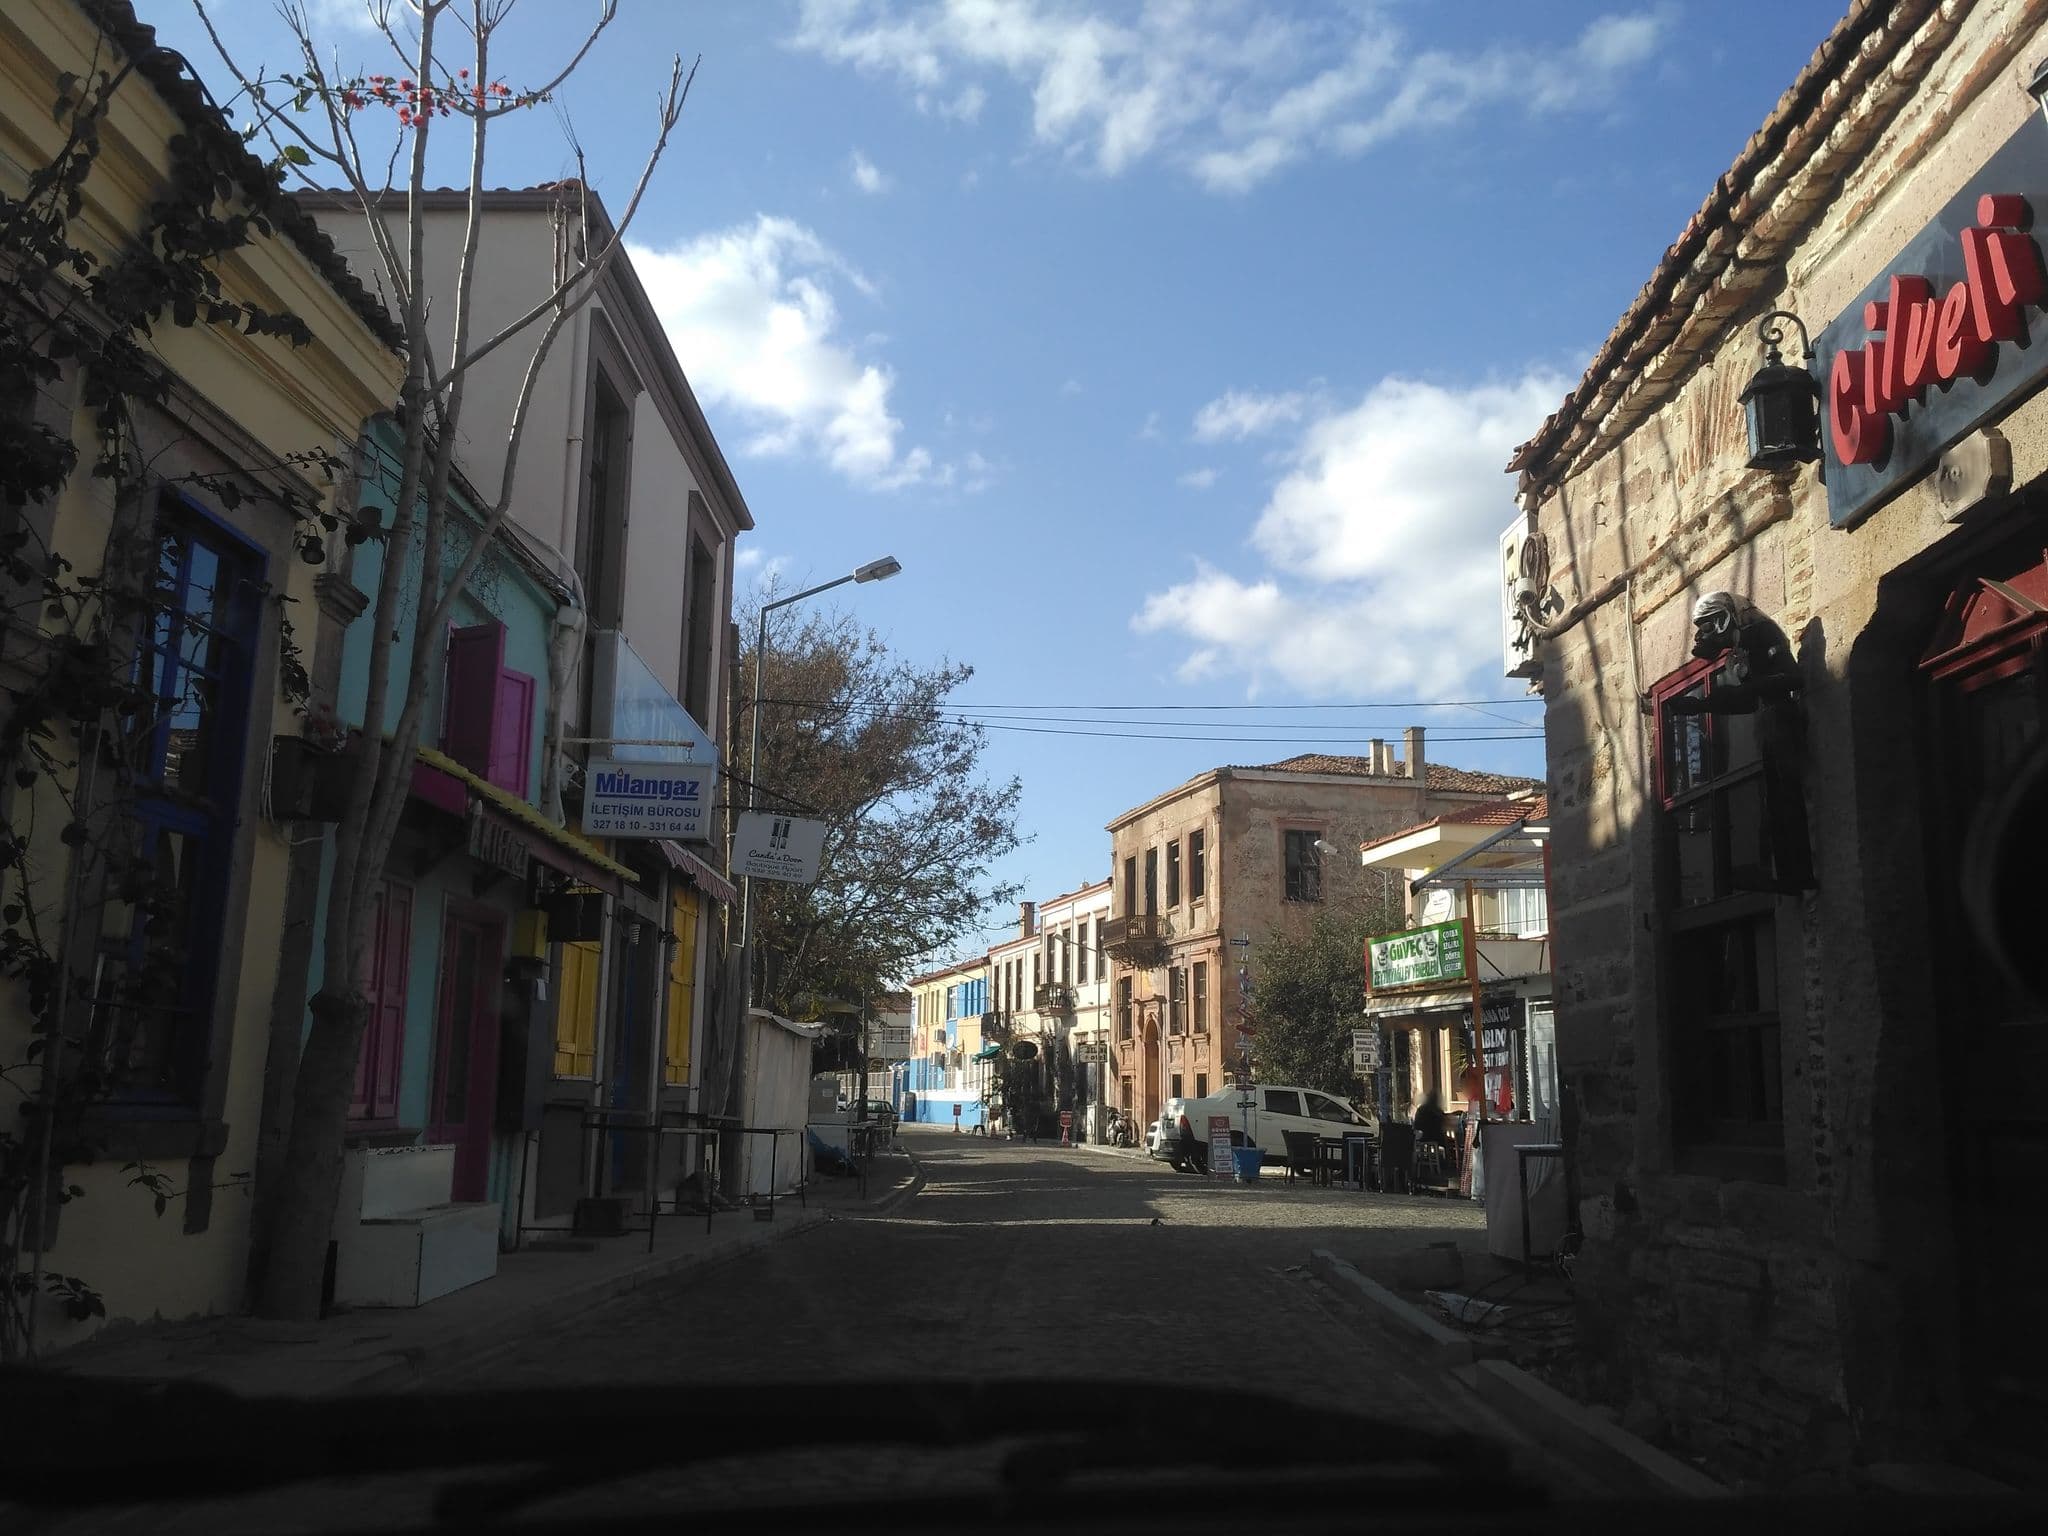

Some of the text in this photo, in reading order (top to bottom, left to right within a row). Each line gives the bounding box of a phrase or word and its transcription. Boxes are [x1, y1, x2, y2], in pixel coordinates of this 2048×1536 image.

[1829, 192, 2036, 465] Cilveli
[595, 769, 700, 801] Milangaz
[591, 802, 701, 818] İLETİŞİM BÜROSU
[592, 819, 611, 829] 327
[630, 820, 640, 830] 10
[649, 822, 666, 831] 331
[669, 822, 681, 832] 64
[684, 822, 696, 832] 44
